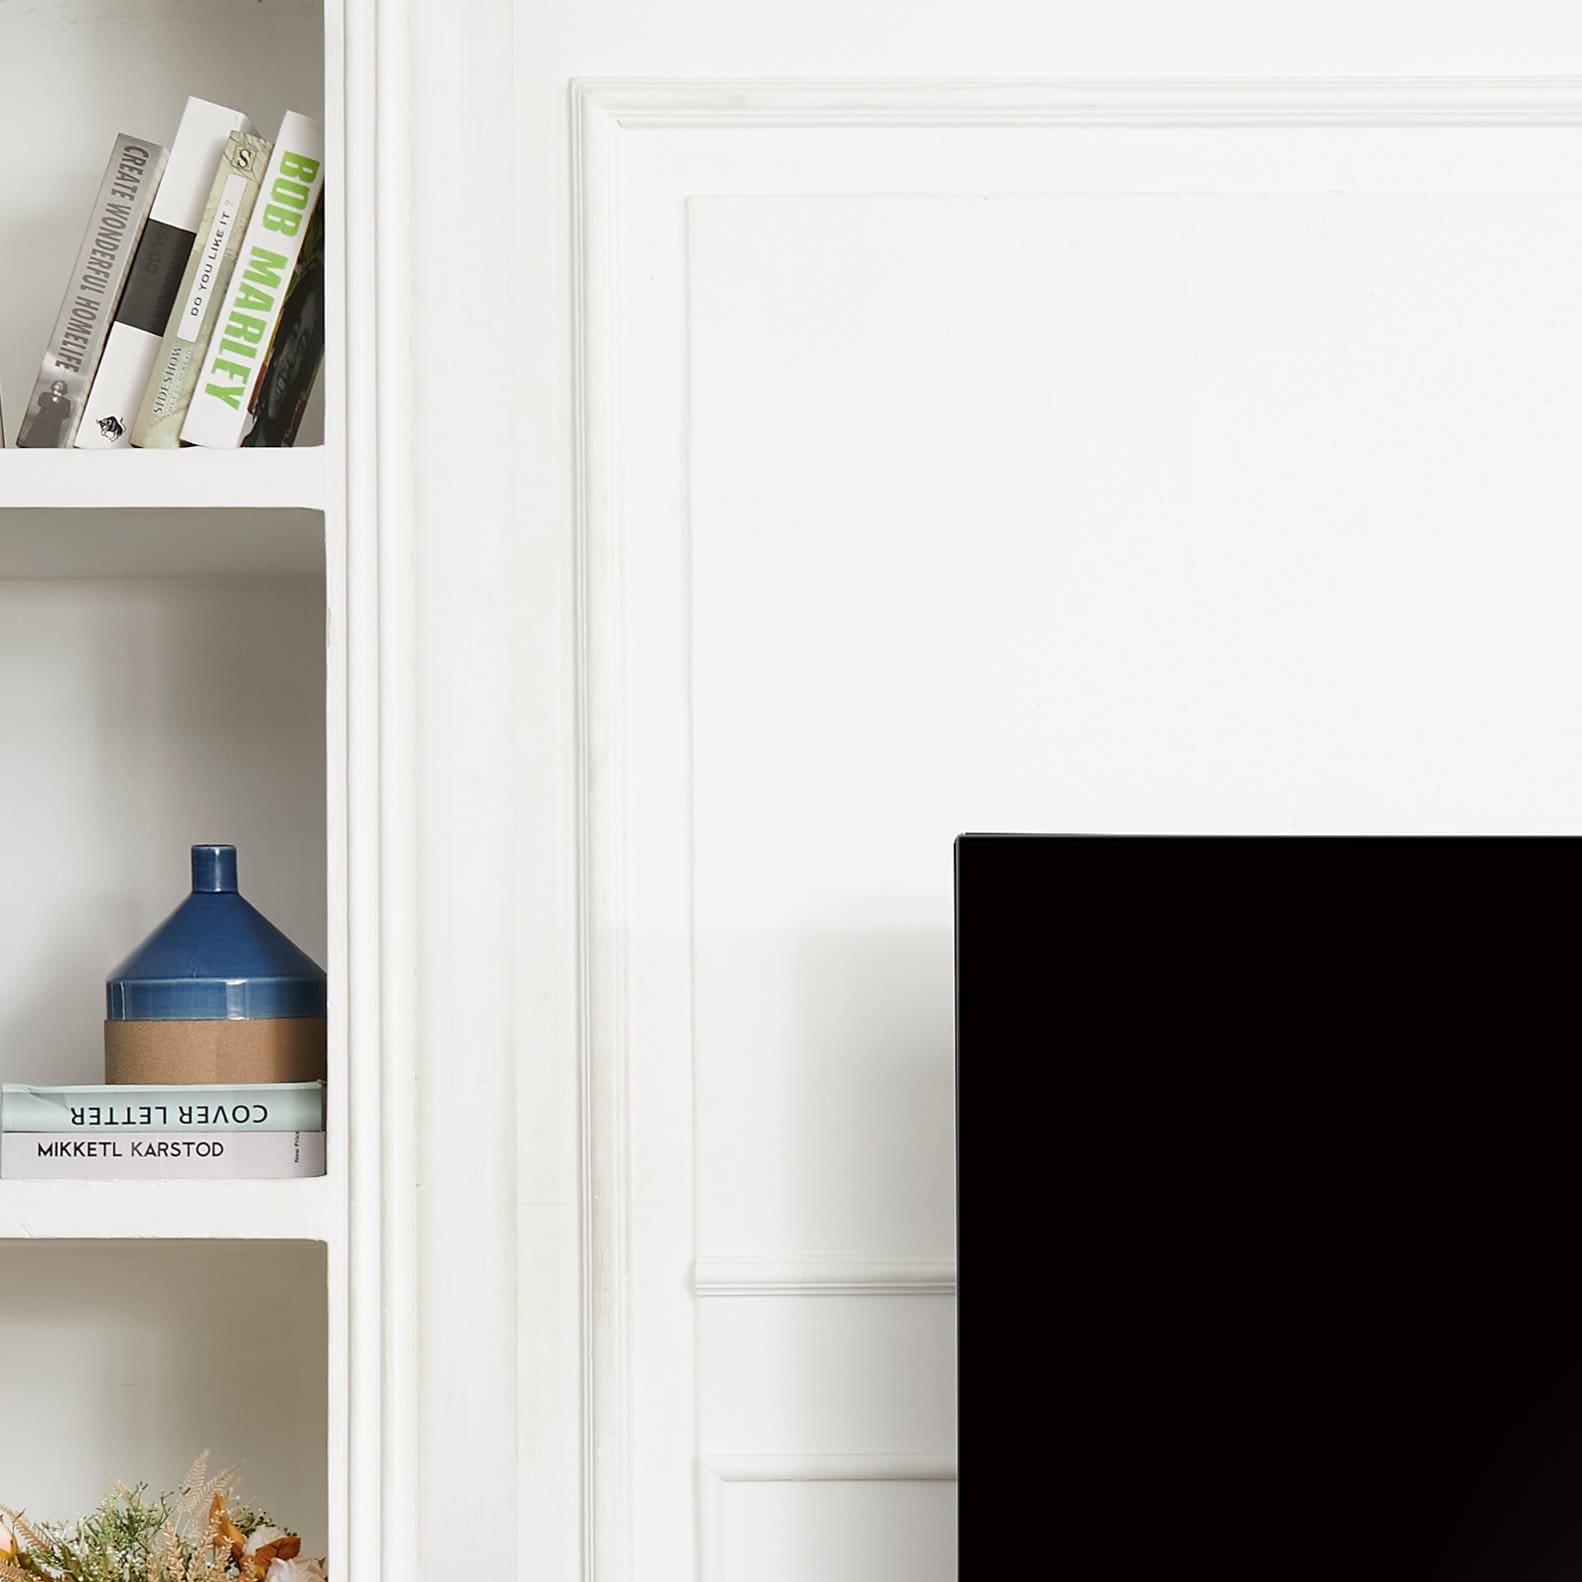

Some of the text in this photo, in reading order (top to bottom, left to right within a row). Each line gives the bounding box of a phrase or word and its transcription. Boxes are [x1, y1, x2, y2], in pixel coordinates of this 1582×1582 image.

[219, 210, 230, 226] IT
[54, 145, 150, 374] CREATE WONDERFUL HOMELIFE
[205, 228, 226, 263] LIKE
[194, 264, 216, 295] YOU
[204, 151, 321, 411] BOB MARLEY
[190, 297, 204, 317] DO
[152, 346, 184, 415] SIDESHOW
[70, 1104, 268, 1125] COVER LETTER
[38, 1141, 224, 1157] MIKKETL KARSTOD
